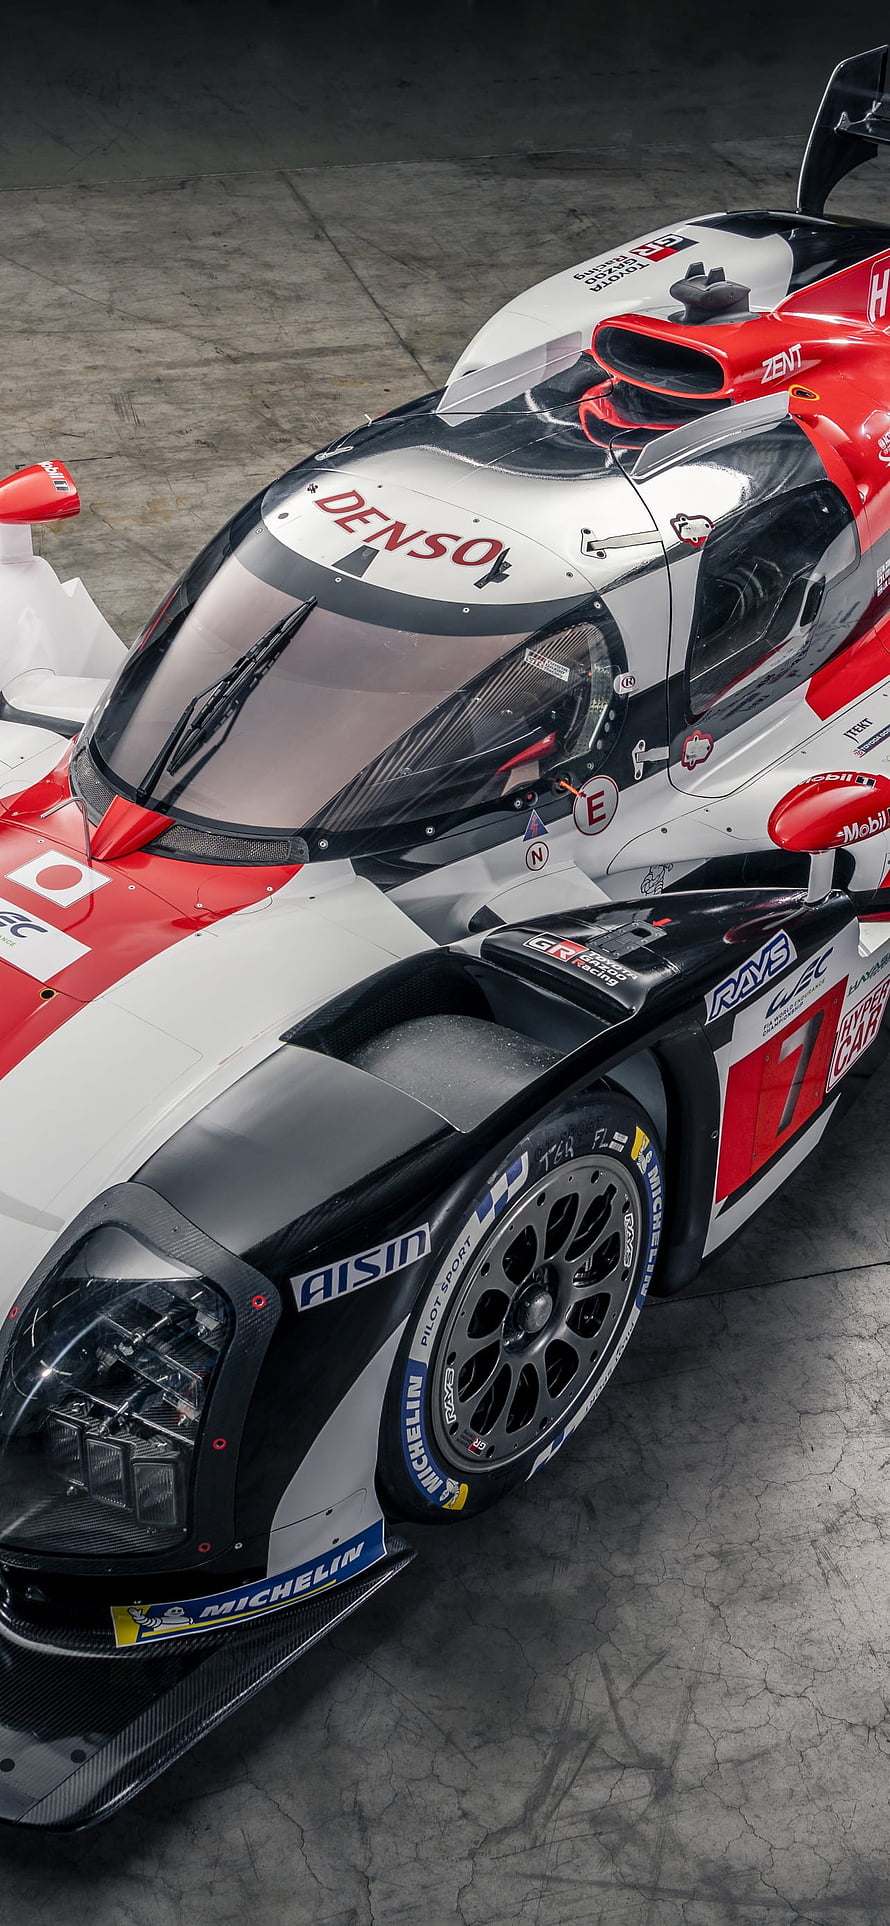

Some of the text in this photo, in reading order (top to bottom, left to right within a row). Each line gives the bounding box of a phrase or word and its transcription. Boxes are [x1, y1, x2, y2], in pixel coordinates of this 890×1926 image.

[631, 234, 684, 257] GR
[573, 255, 629, 281] Racing
[584, 258, 639, 285] GAZOO
[589, 262, 650, 293] TOYOTA
[761, 343, 803, 385] ZENT
[313, 489, 506, 567] DENSO
[843, 717, 873, 744] JTEKT
[586, 790, 607, 827] E
[842, 810, 887, 844] Mobil
[527, 936, 577, 961] GR
[579, 954, 628, 981] GAZOO
[587, 950, 639, 980] TOYOTA
[571, 958, 620, 988] Racing
[708, 933, 790, 1022] RAYS
[834, 1002, 883, 1077] CAR
[776, 1009, 825, 1137] 7
[640, 1164, 663, 1297] MICHELIN
[300, 1229, 427, 1308] AISIN
[421, 1235, 474, 1348] PILOT SPORT
[444, 1367, 457, 1425] RAYS
[405, 1375, 444, 1494] MICHELIN
[199, 1542, 366, 1619] MICHELIN
